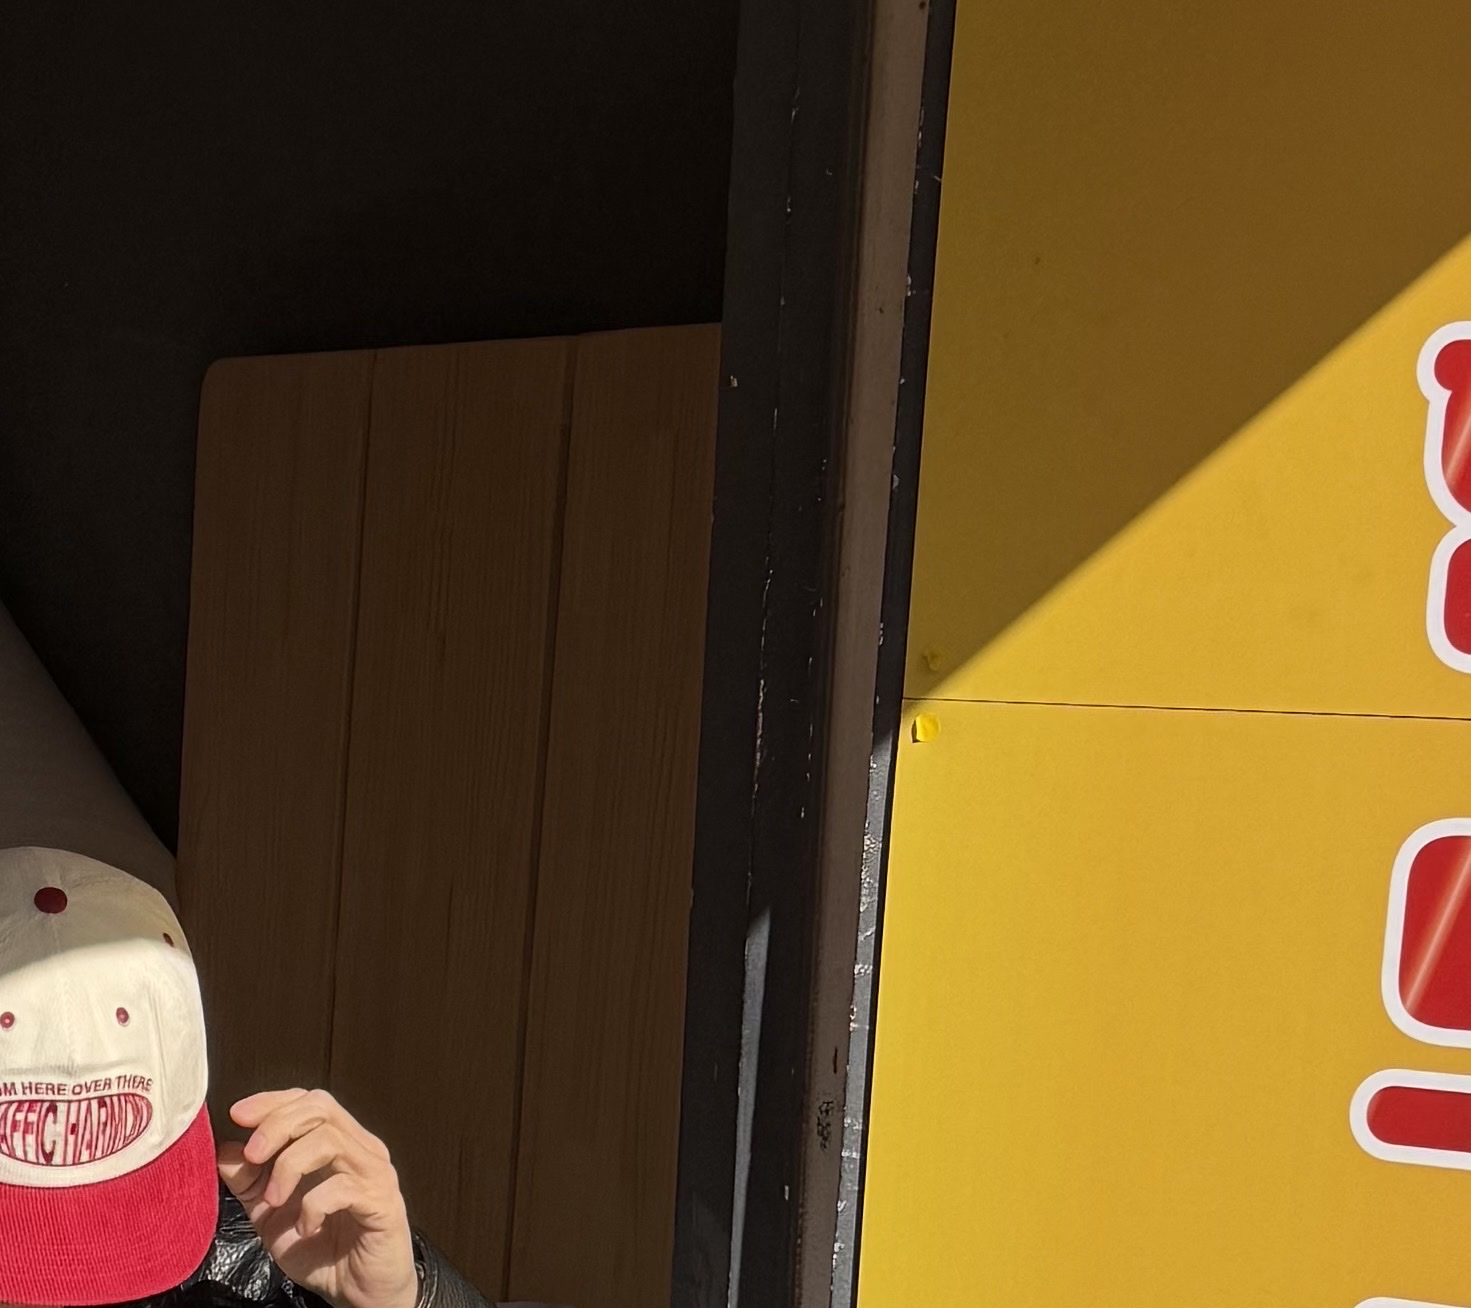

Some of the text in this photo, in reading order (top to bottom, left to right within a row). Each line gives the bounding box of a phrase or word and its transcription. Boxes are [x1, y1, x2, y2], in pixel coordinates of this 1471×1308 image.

[22, 1081, 67, 1096] HERE
[72, 1077, 112, 1096] OVER
[116, 1074, 154, 1093] THERE
